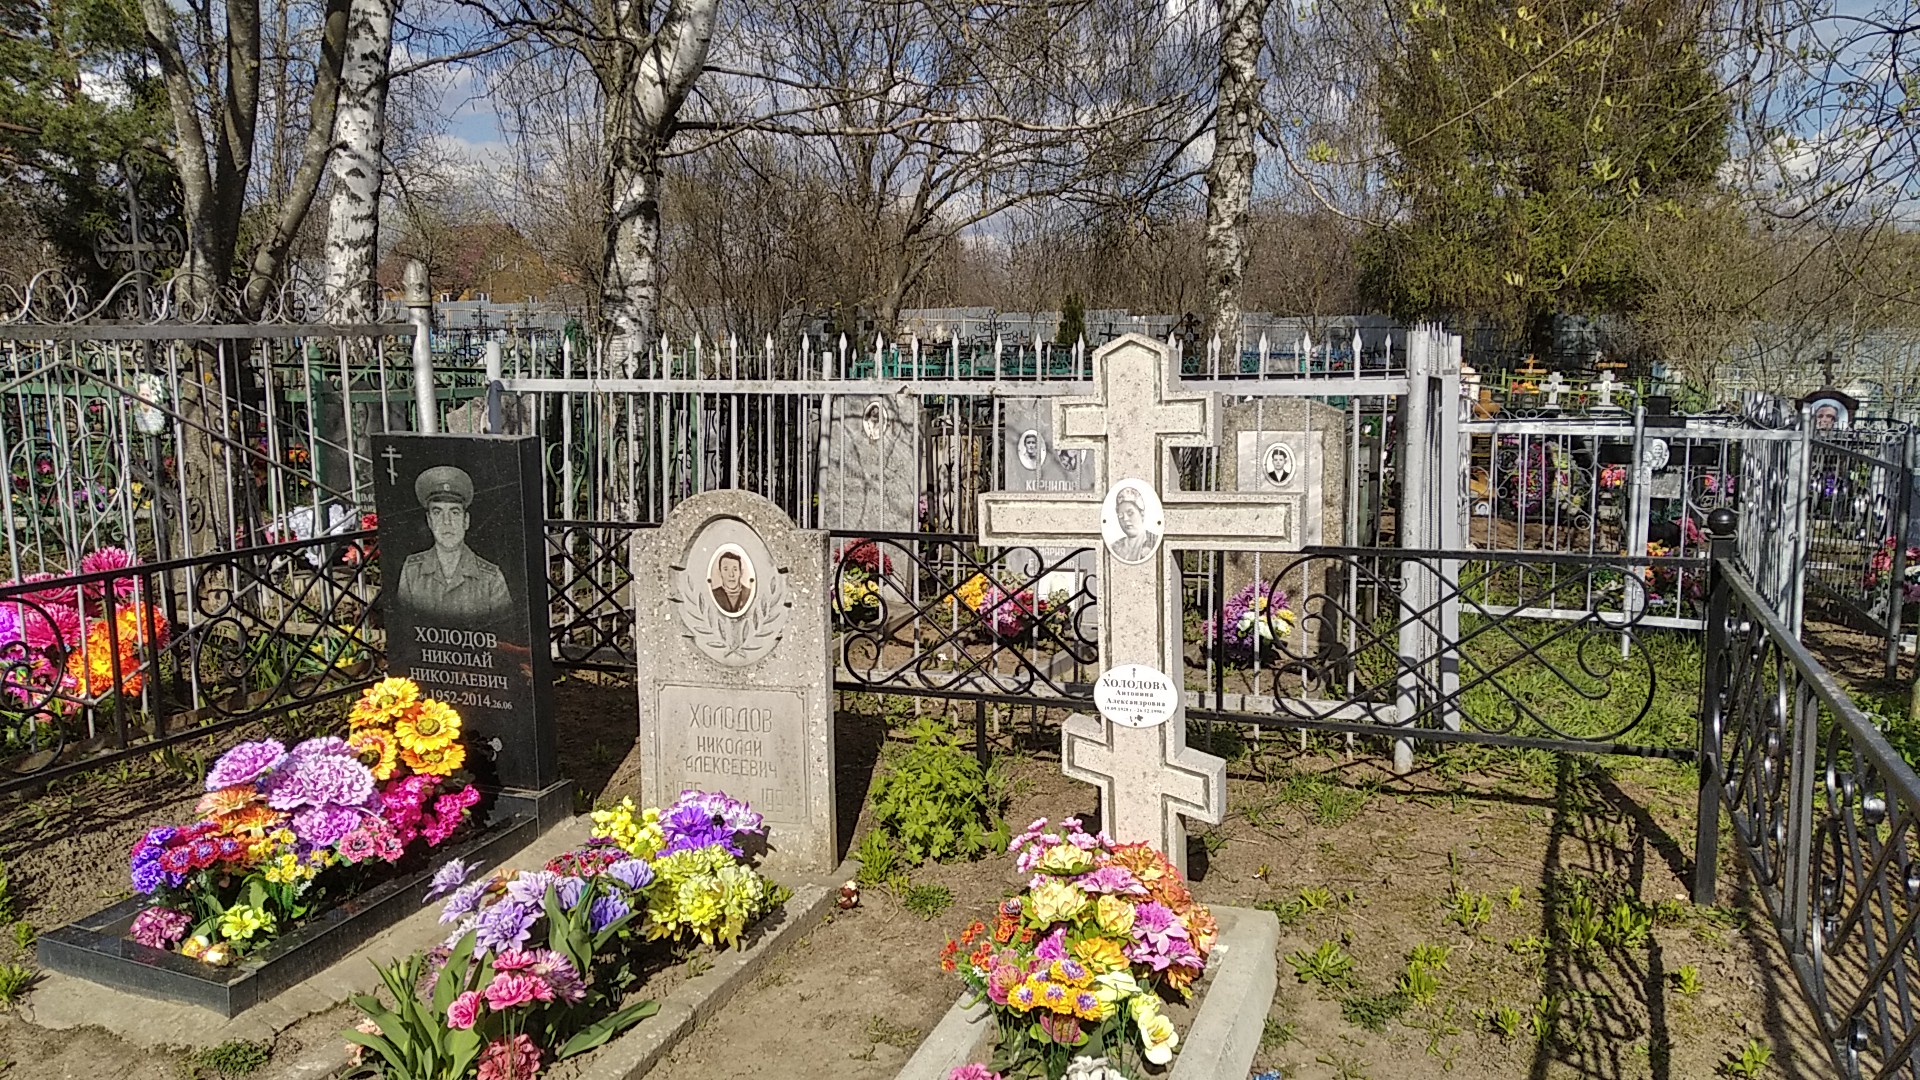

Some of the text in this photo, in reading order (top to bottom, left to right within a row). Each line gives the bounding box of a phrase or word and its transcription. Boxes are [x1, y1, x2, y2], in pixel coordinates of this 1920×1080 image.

[414, 626, 498, 649] ХОЛОДОВ
[421, 648, 494, 668] НИКОЛАЙ
[409, 667, 509, 690] НИКОЛАЕВИЧ
[1103, 678, 1168, 691] ХОЛОДОВА
[689, 703, 773, 733] ХОЛОДОВ
[696, 736, 763, 757] НИКОЛАЙ
[684, 755, 778, 779] АЛЕКСЕЕВИЧ
